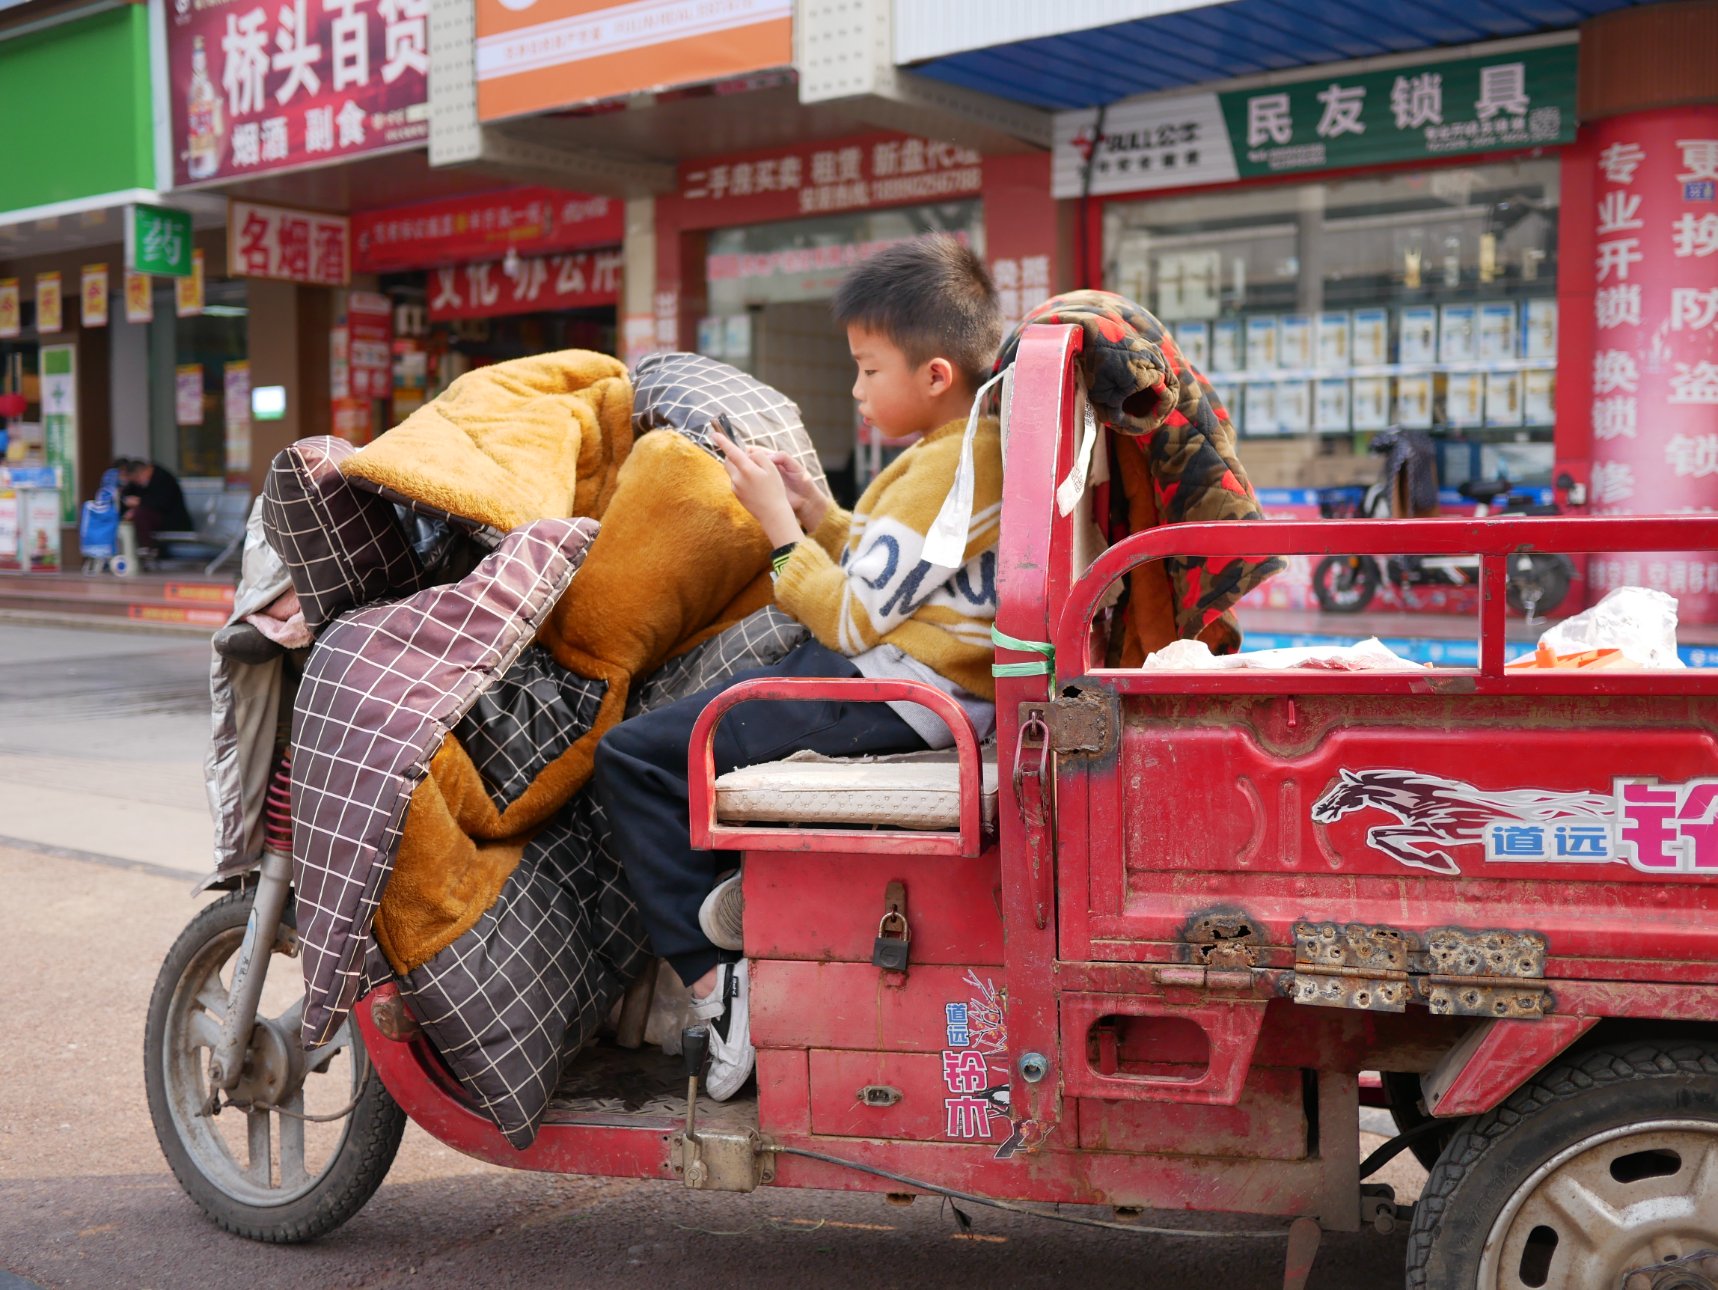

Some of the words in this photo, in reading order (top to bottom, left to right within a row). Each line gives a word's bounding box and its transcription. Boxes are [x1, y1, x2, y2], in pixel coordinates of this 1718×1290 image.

[222, 0, 430, 116] 桥头百货
[231, 116, 288, 167] 烟酒
[304, 99, 366, 153] 副食
[1247, 62, 1529, 148] 民友锁具
[685, 156, 801, 199] 二手房买卖
[142, 218, 184, 266] 药
[239, 209, 345, 285] 名烟酒
[1593, 140, 1646, 329] 专业开锁
[1664, 139, 1718, 514] 更换防盗锁
[1590, 348, 1640, 441] 换锁
[1491, 825, 1608, 857] 道远
[946, 1003, 970, 1047] 道远
[943, 1050, 991, 1137] 铃木
